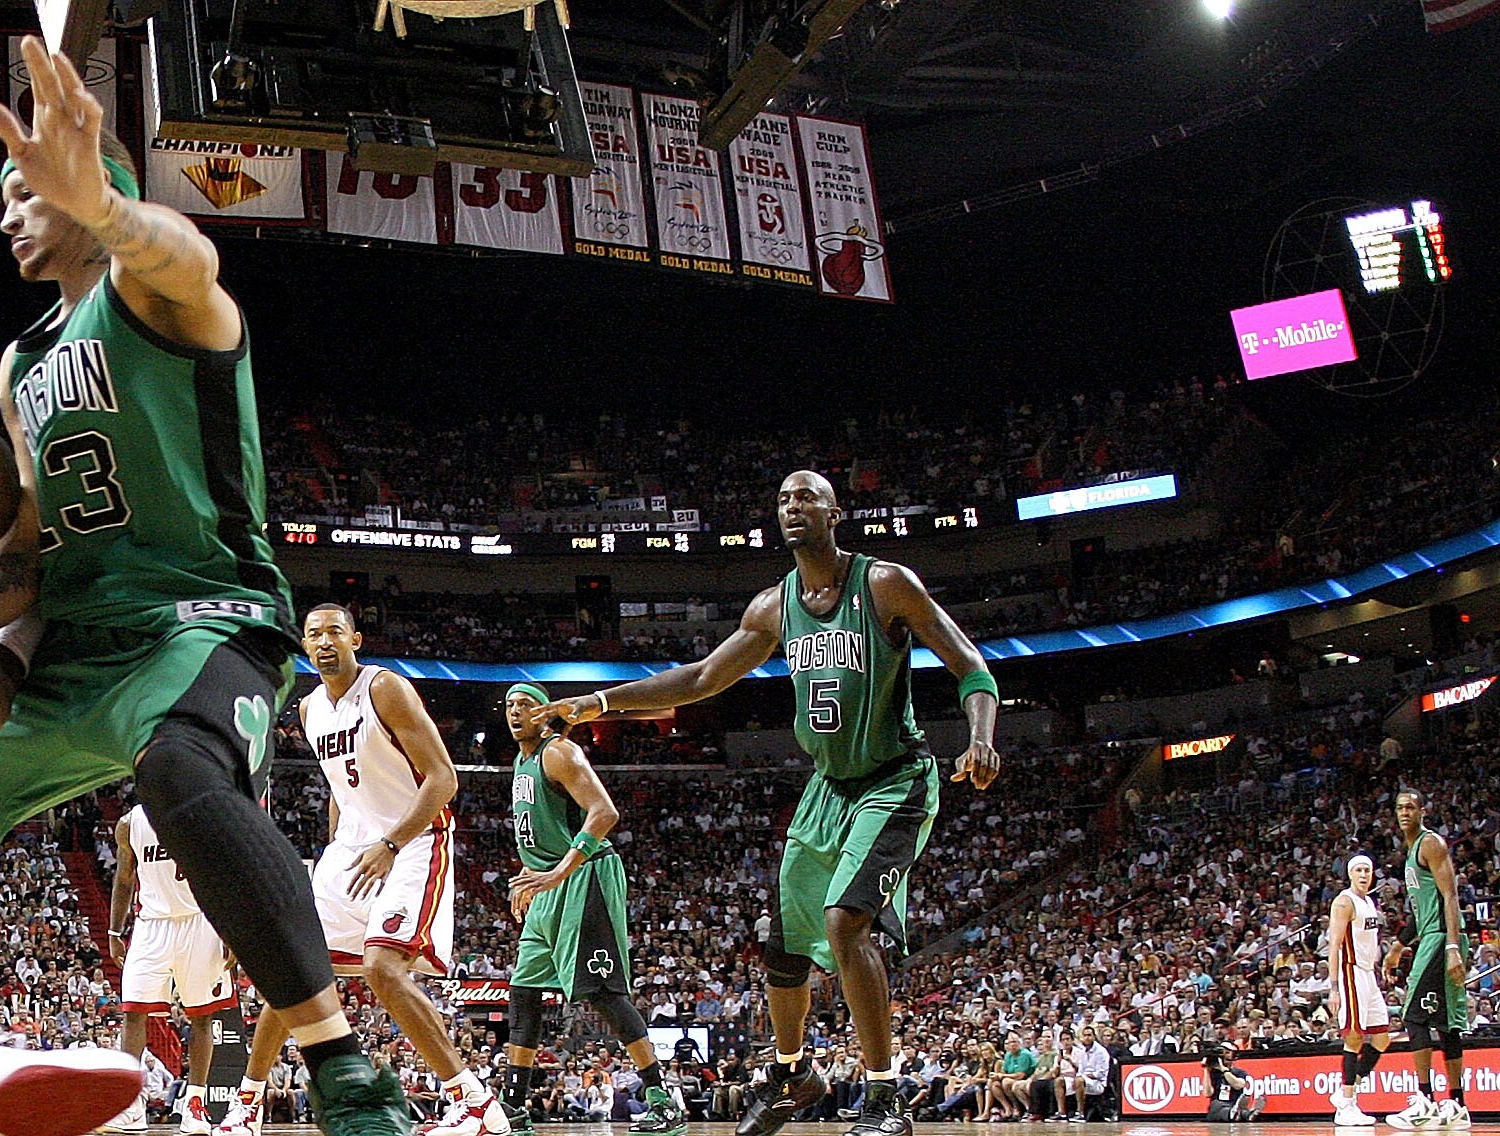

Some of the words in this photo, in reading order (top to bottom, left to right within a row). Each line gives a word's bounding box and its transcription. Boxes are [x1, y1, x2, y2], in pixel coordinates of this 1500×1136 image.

[585, 89, 610, 103] TIM
[583, 102, 632, 120] RDAWAY
[752, 118, 789, 135] YANE
[592, 132, 629, 154] SA
[740, 128, 781, 146] WADE
[817, 132, 846, 144] RON
[657, 144, 711, 168] USA
[739, 155, 791, 180] USA
[824, 172, 852, 182] HEAD
[815, 181, 866, 195] ATHLETIC
[816, 191, 867, 205] TRAINER
[575, 242, 605, 256] GOLD
[608, 246, 650, 262] MEDAL
[660, 255, 690, 270] GOLD
[693, 259, 734, 274] MEDAL
[742, 265, 772, 279] GOLD
[774, 270, 813, 285] MEDAL
[40, 431, 132, 553] 3
[864, 524, 887, 535] FTA
[893, 517, 906, 528] 21
[331, 529, 411, 549] OFFENSIVE
[414, 534, 461, 550] STATS
[572, 537, 597, 549] FGM
[646, 537, 670, 548] FGA
[787, 630, 865, 680] BOSTON
[808, 679, 842, 732] 5
[316, 716, 363, 760] HEAT
[345, 759, 359, 788] 5
[513, 810, 535, 849] 4
[144, 844, 170, 862] HE
[209, 1086, 241, 1102] NBA
[1133, 1076, 1167, 1100] KIA
[1180, 1076, 1204, 1097] All-
[1380, 1069, 1447, 1093] Vehile
